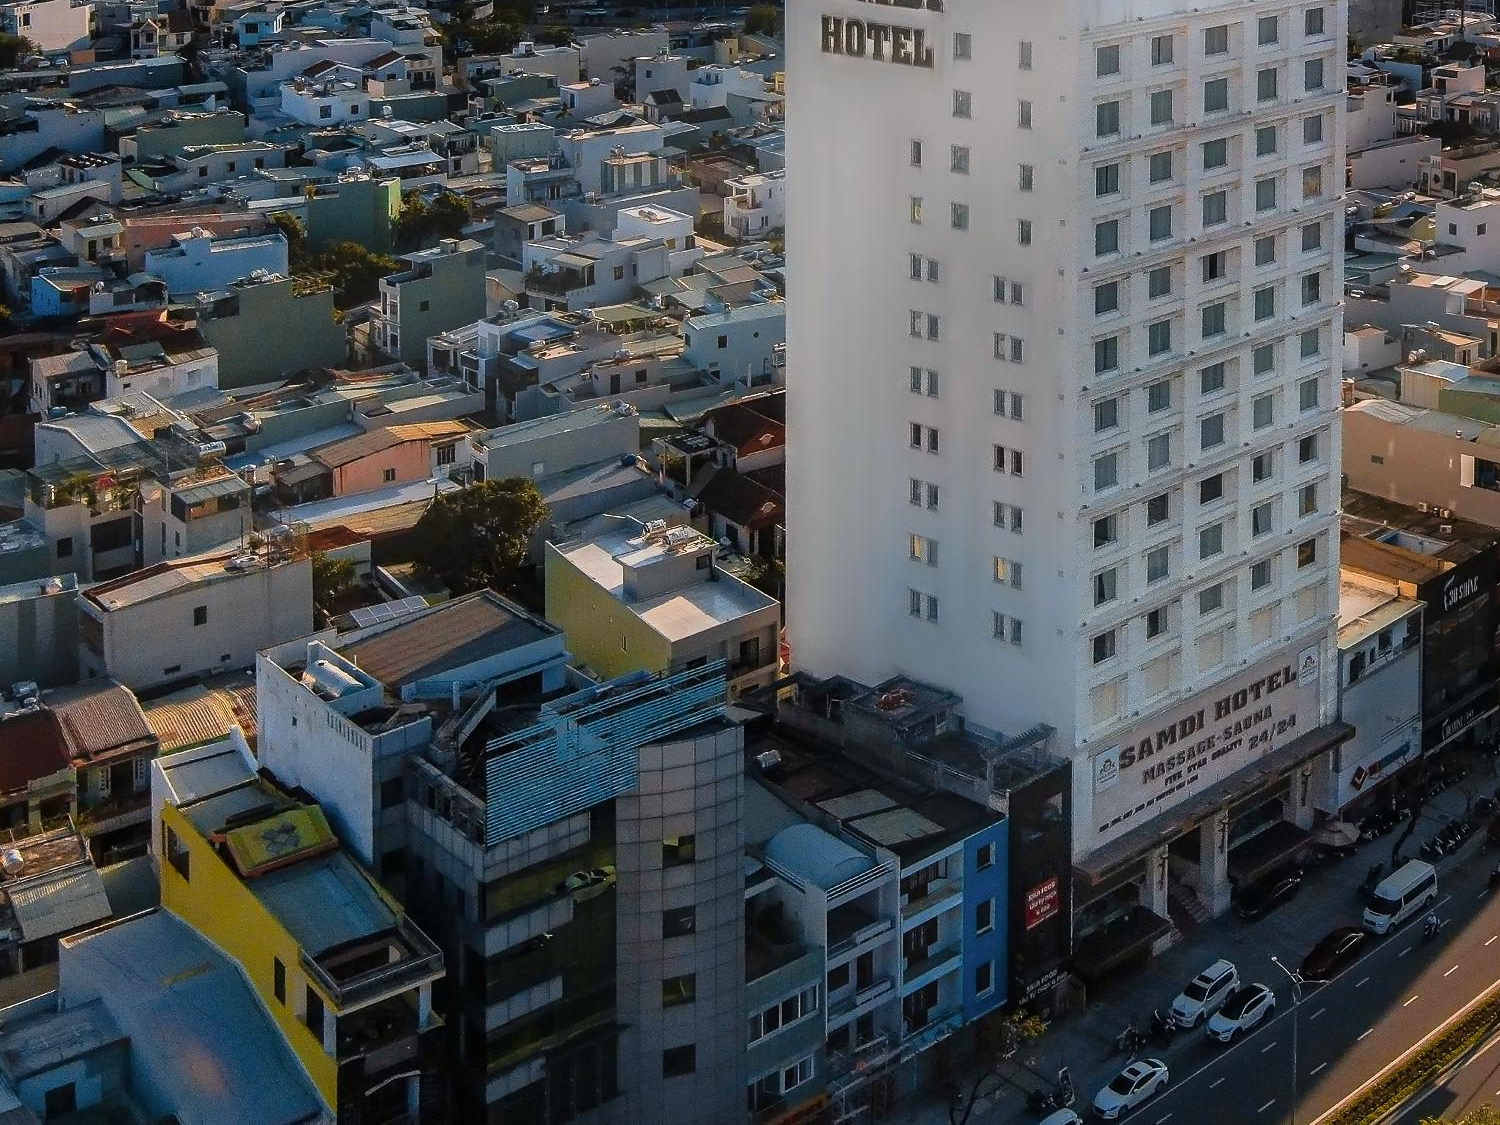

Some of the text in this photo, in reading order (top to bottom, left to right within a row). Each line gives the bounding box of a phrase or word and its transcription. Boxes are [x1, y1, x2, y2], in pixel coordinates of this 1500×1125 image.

[821, 14, 935, 69] HOTEL
[1119, 664, 1298, 769] SAMDI HOTEL
[1248, 713, 1297, 751] 24/24
